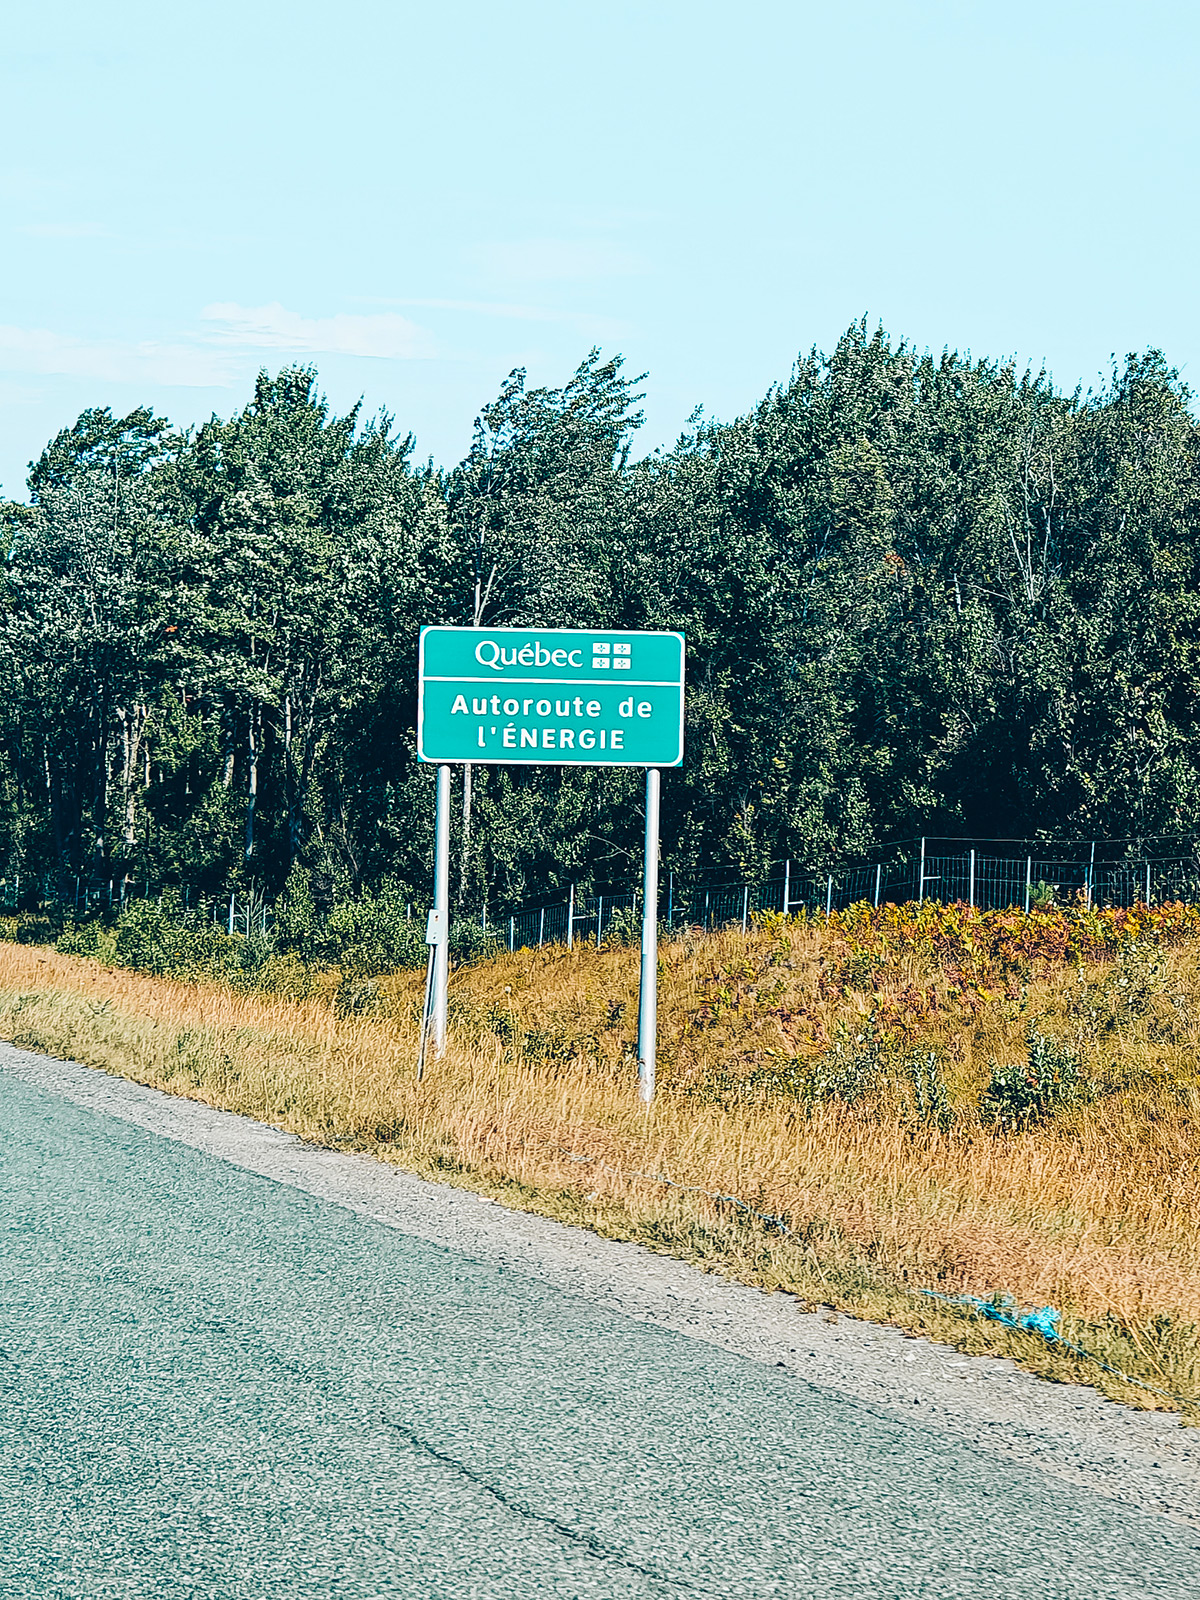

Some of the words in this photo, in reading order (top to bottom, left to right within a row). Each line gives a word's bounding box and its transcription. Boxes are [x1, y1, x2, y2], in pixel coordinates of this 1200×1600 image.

[475, 640, 583, 670] Québec
[451, 694, 601, 718] Autoroute
[618, 696, 652, 718] de
